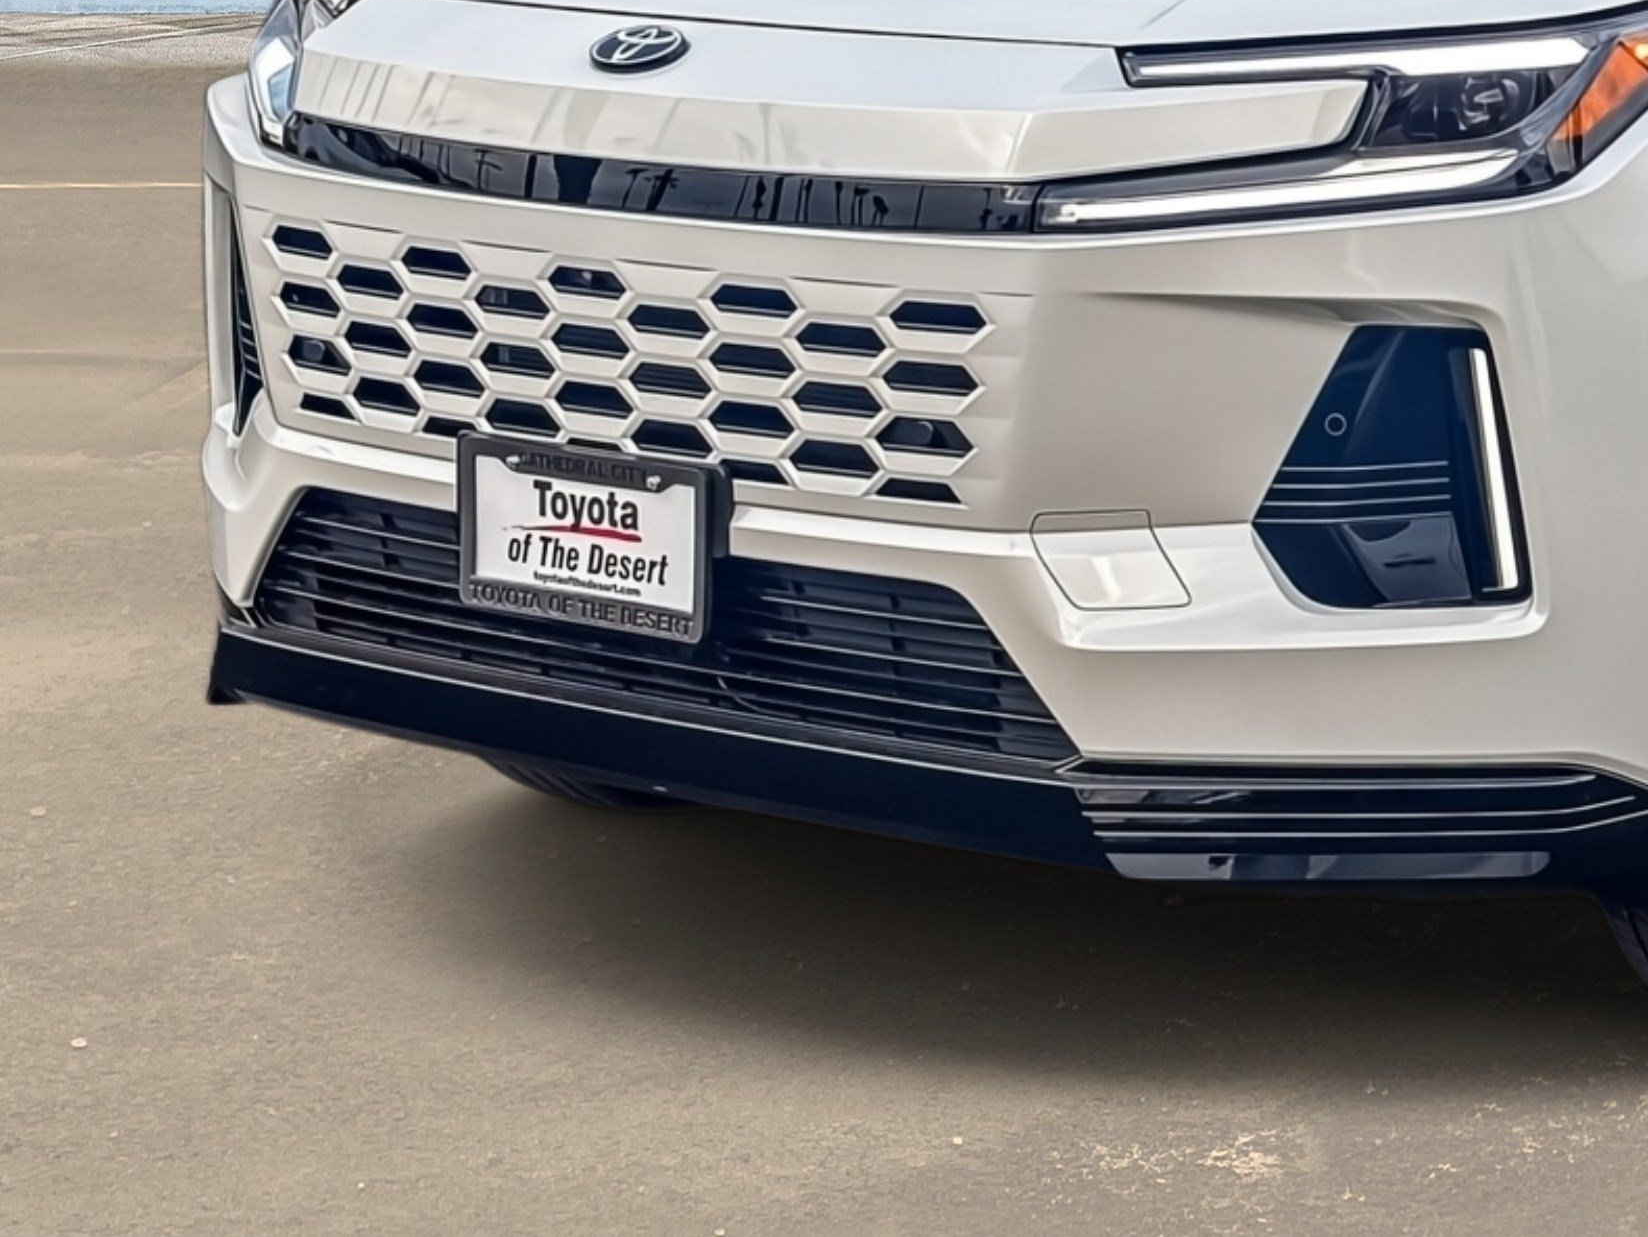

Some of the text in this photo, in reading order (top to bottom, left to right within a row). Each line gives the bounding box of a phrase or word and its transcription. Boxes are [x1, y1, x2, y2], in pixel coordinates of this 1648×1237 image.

[532, 479, 640, 530] Toyota
[507, 533, 669, 586] of The Desert
[469, 581, 694, 635] TOYOTA OF THE DESERT
